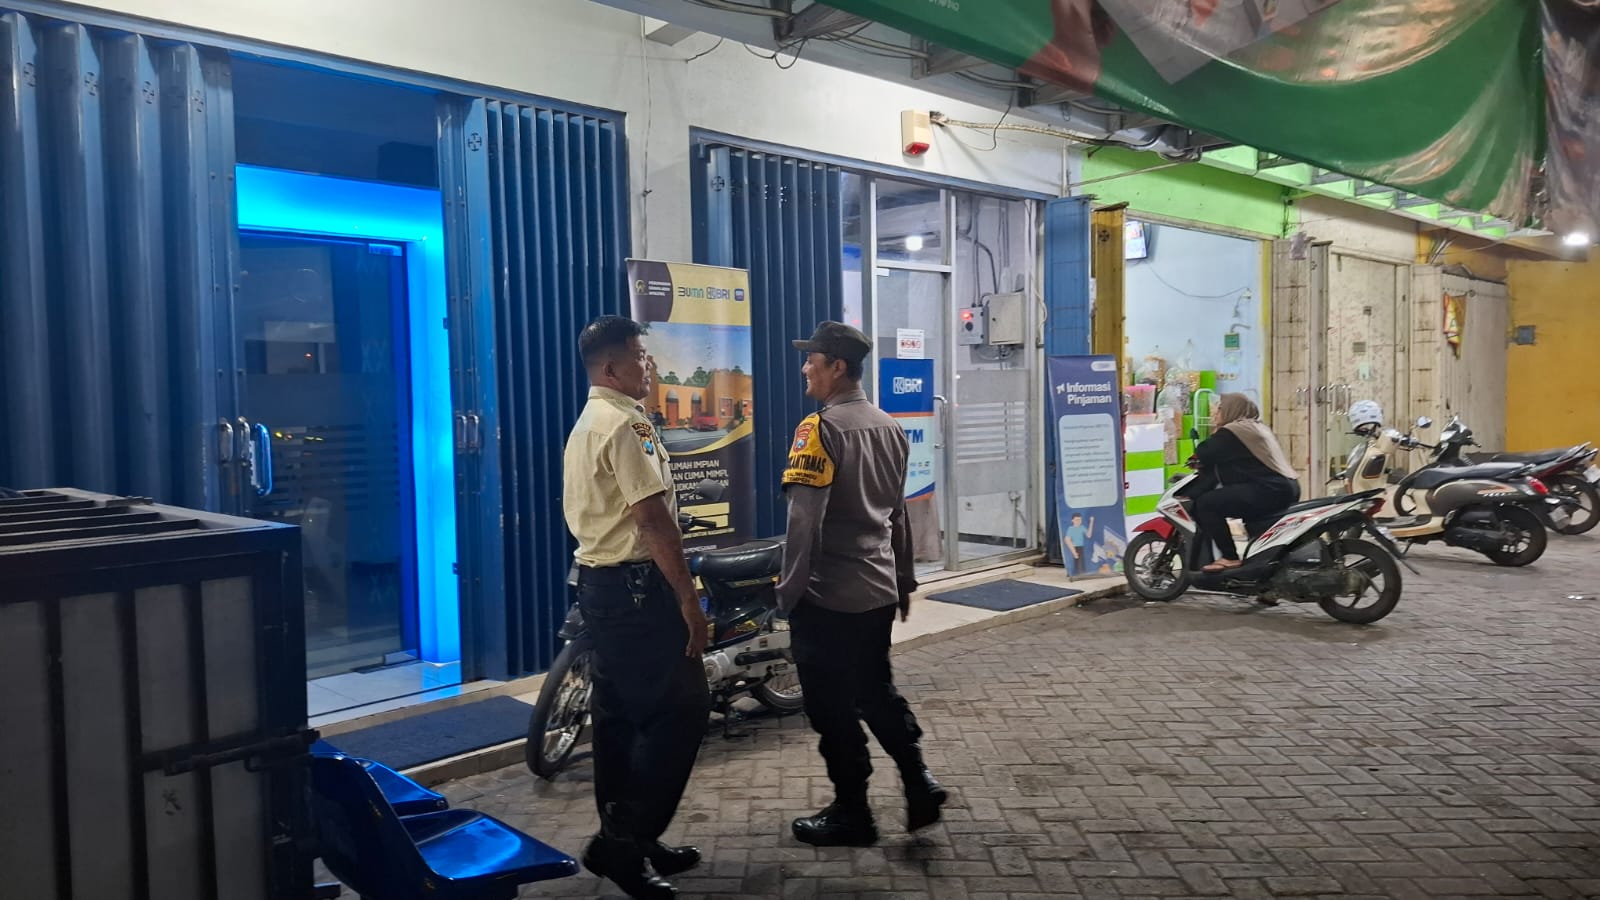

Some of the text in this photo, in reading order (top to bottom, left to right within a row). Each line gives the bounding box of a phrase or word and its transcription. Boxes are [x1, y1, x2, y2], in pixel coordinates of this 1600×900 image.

[1066, 381, 1111, 393] Informasi
[1067, 394, 1112, 407] Pinjaman
[694, 459, 719, 468] IMPIAN
[684, 471, 705, 480] CUMA
